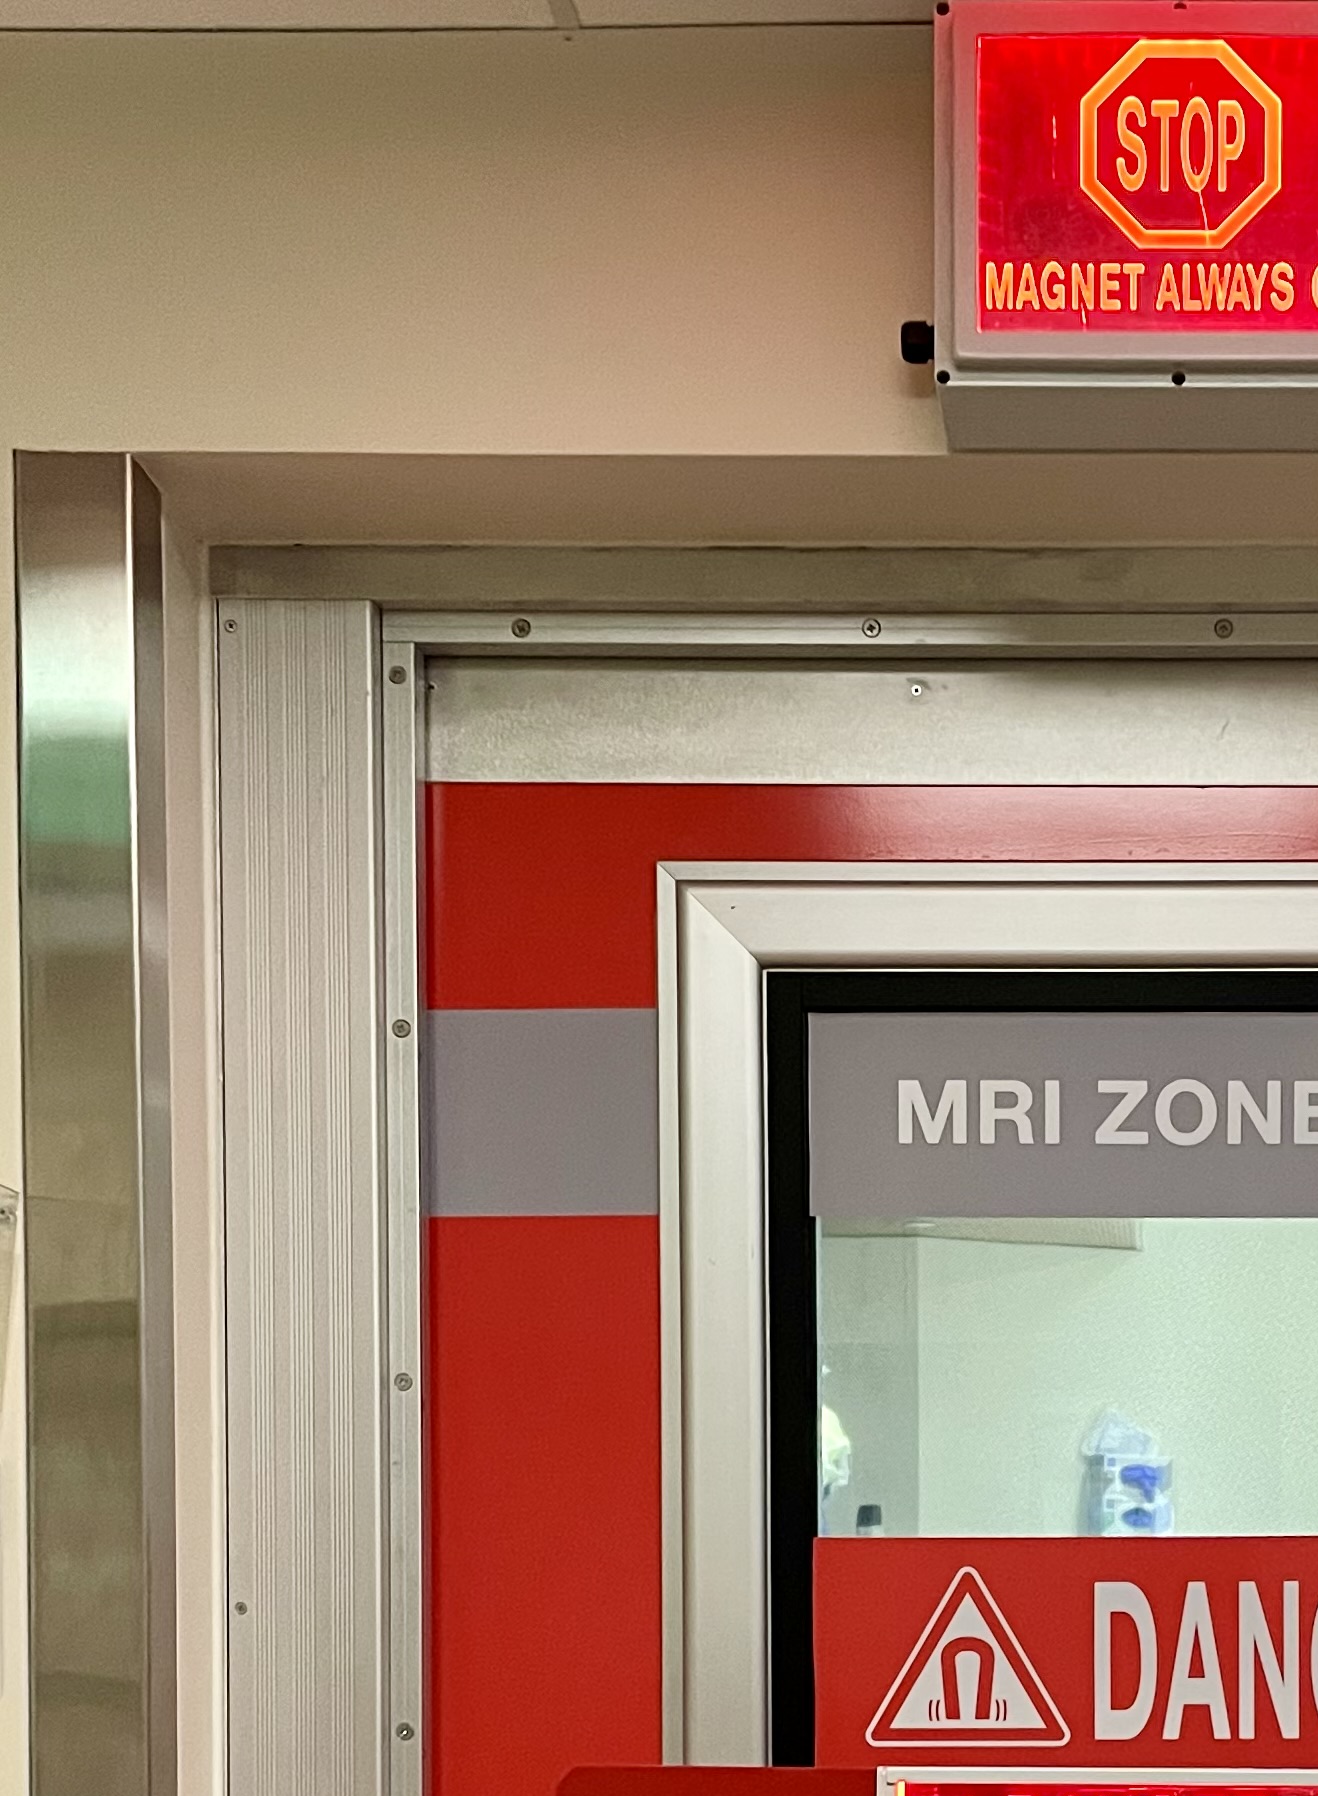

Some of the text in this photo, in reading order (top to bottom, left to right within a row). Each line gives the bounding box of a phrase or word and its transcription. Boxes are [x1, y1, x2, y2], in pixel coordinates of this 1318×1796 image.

[1115, 96, 1246, 193] STOP
[985, 261, 1145, 312] MAGNET
[1156, 261, 1294, 312] ALWAYS
[898, 1079, 1060, 1145] MRI
